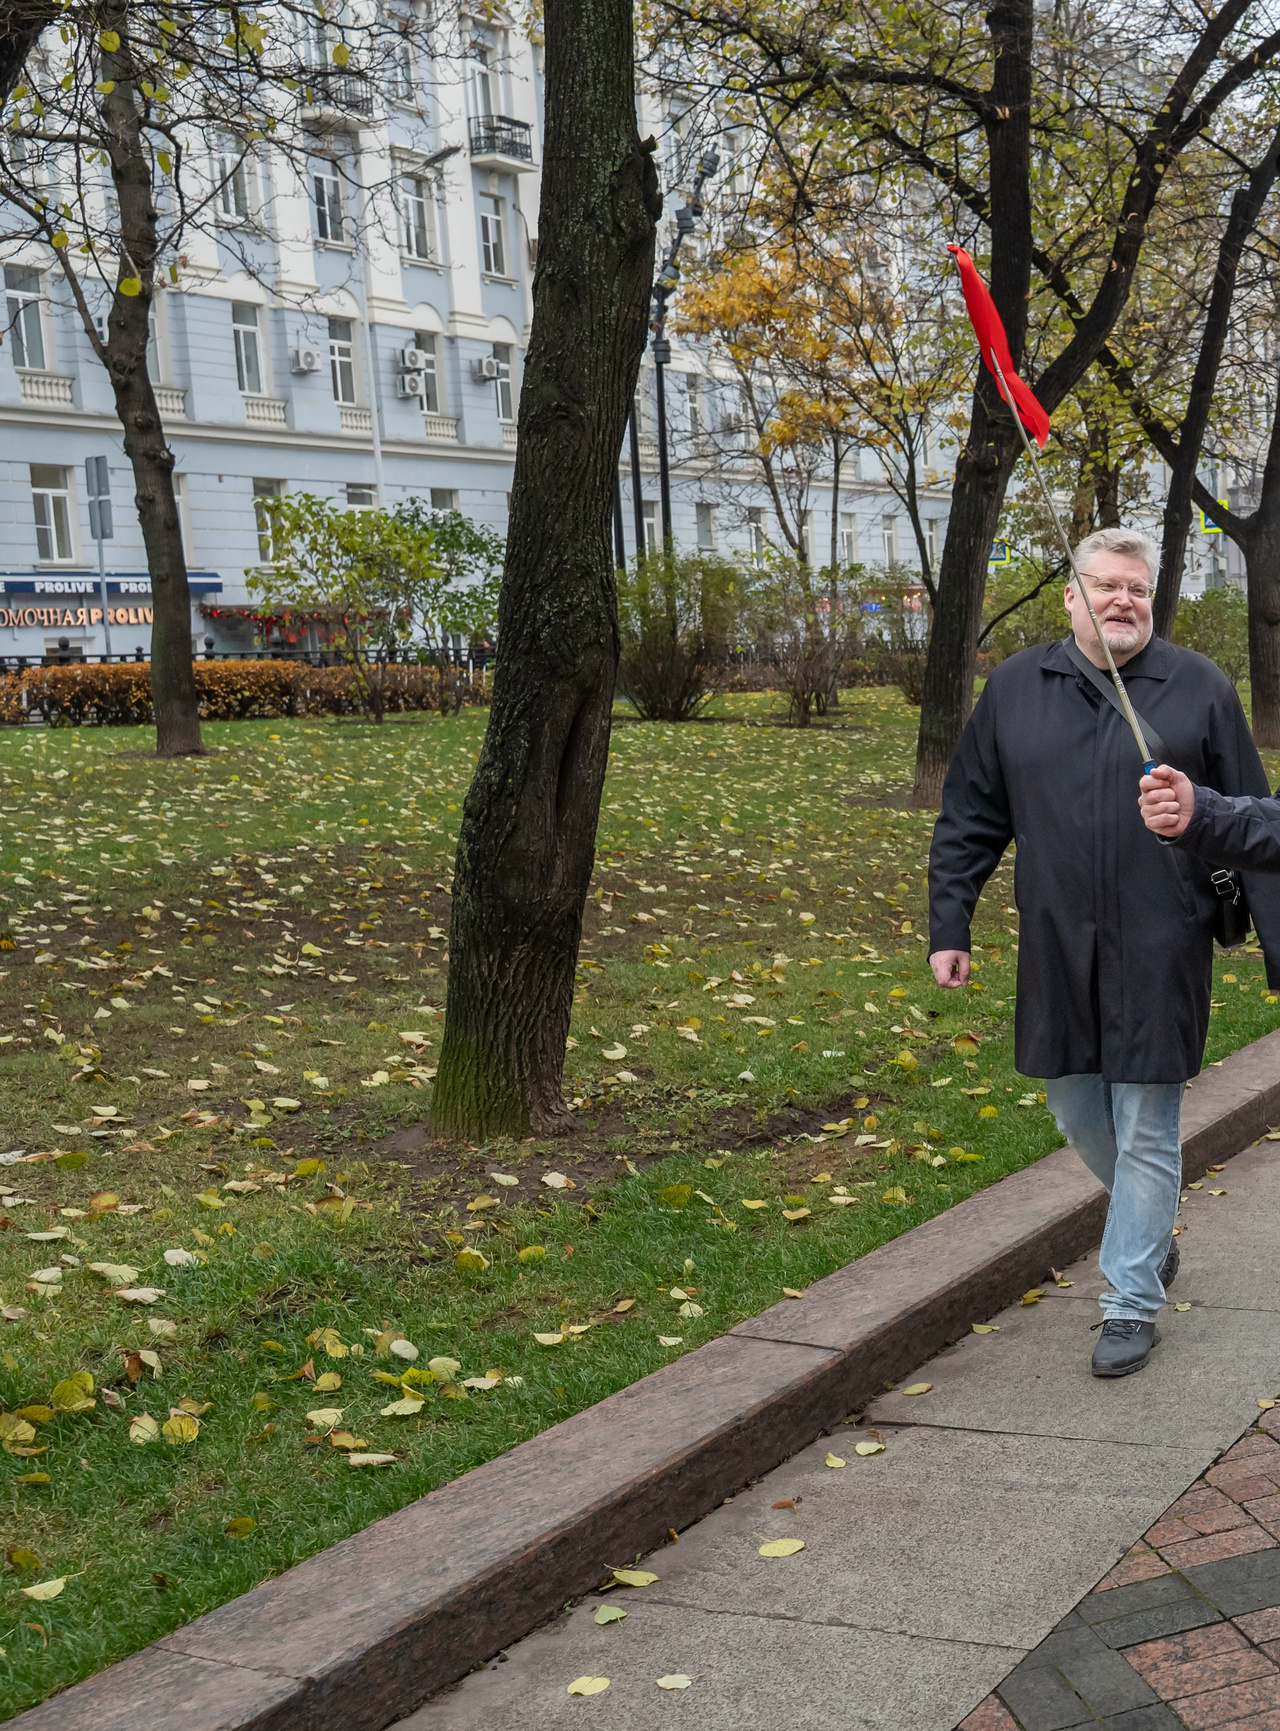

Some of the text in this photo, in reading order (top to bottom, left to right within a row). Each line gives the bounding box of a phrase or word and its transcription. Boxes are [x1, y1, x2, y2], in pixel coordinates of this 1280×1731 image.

[34, 582, 94, 593] PROLIVE
[120, 582, 152, 593] PROL
[90, 607, 154, 625] PROLIV
